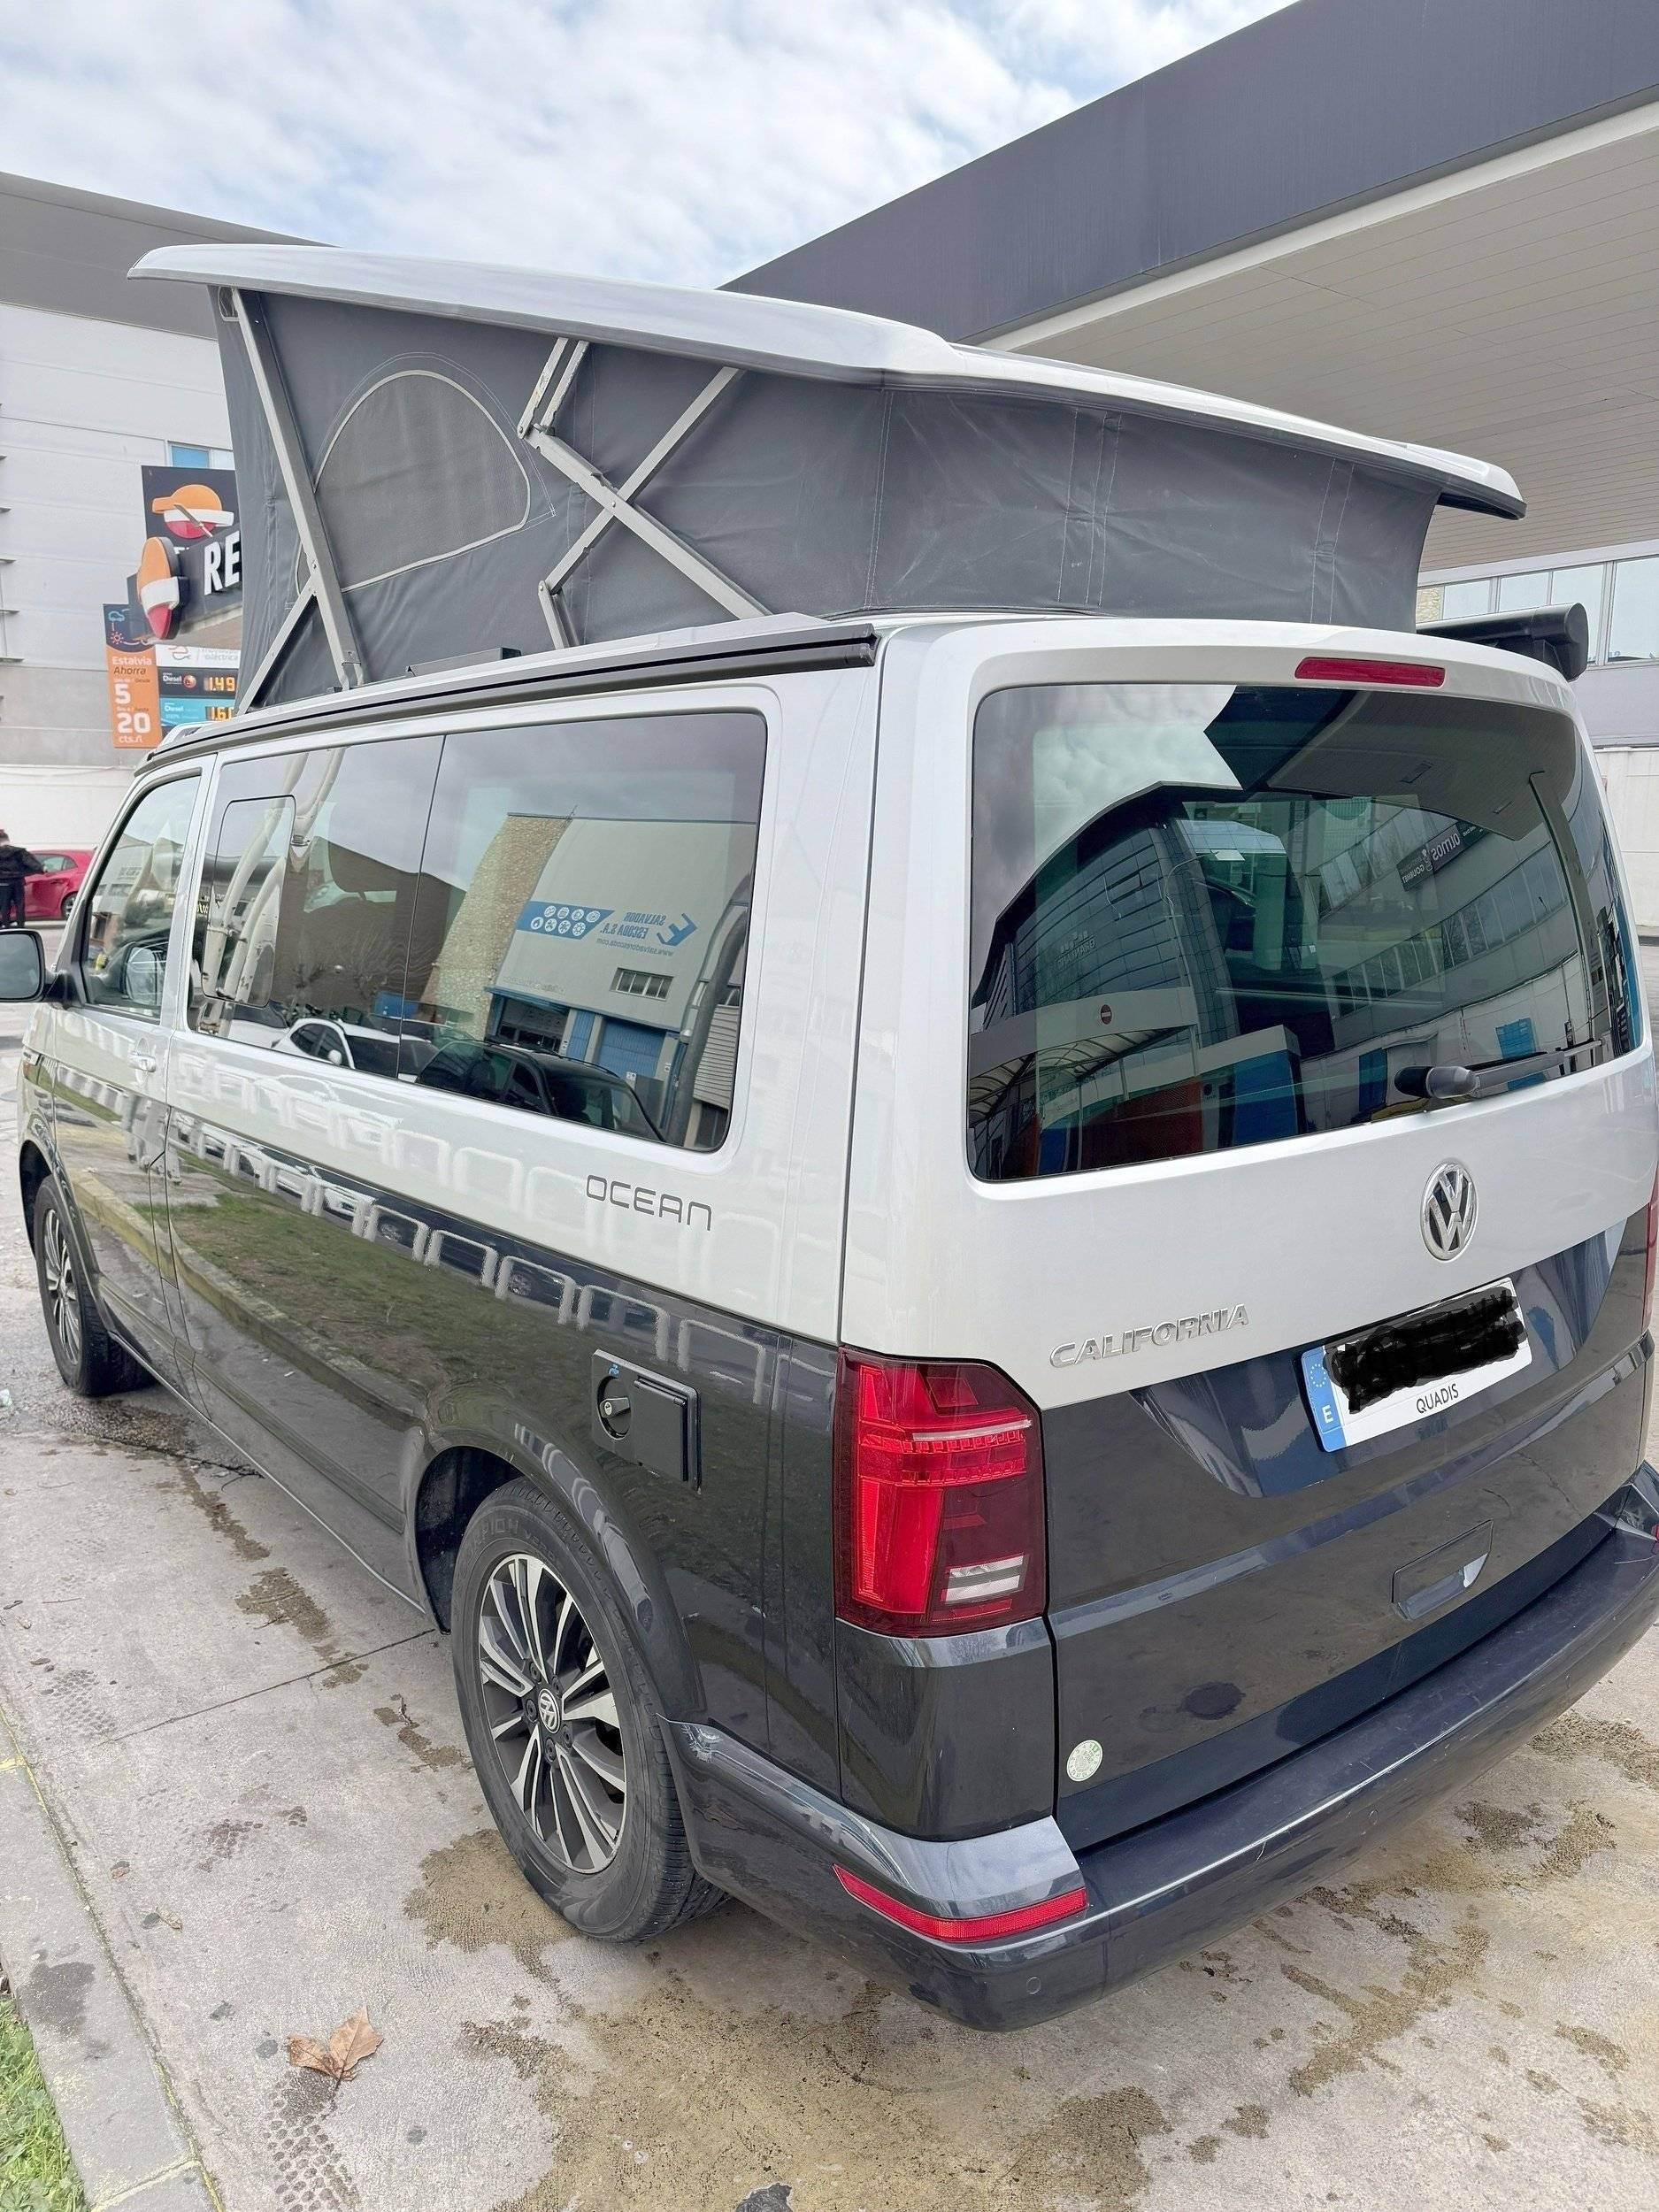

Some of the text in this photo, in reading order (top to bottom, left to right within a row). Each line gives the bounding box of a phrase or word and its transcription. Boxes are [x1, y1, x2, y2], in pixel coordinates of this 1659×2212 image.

[111, 656, 152, 665] Estalvia
[113, 666, 146, 675] Ahorra
[114, 683, 131, 704] 5
[116, 711, 150, 733] 20
[587, 1174, 712, 1231] OCEAN
[1049, 1303, 1249, 1368] CALIFORNIA
[1416, 1383, 1460, 1414] QUADIS
[1321, 1404, 1334, 1424] E
